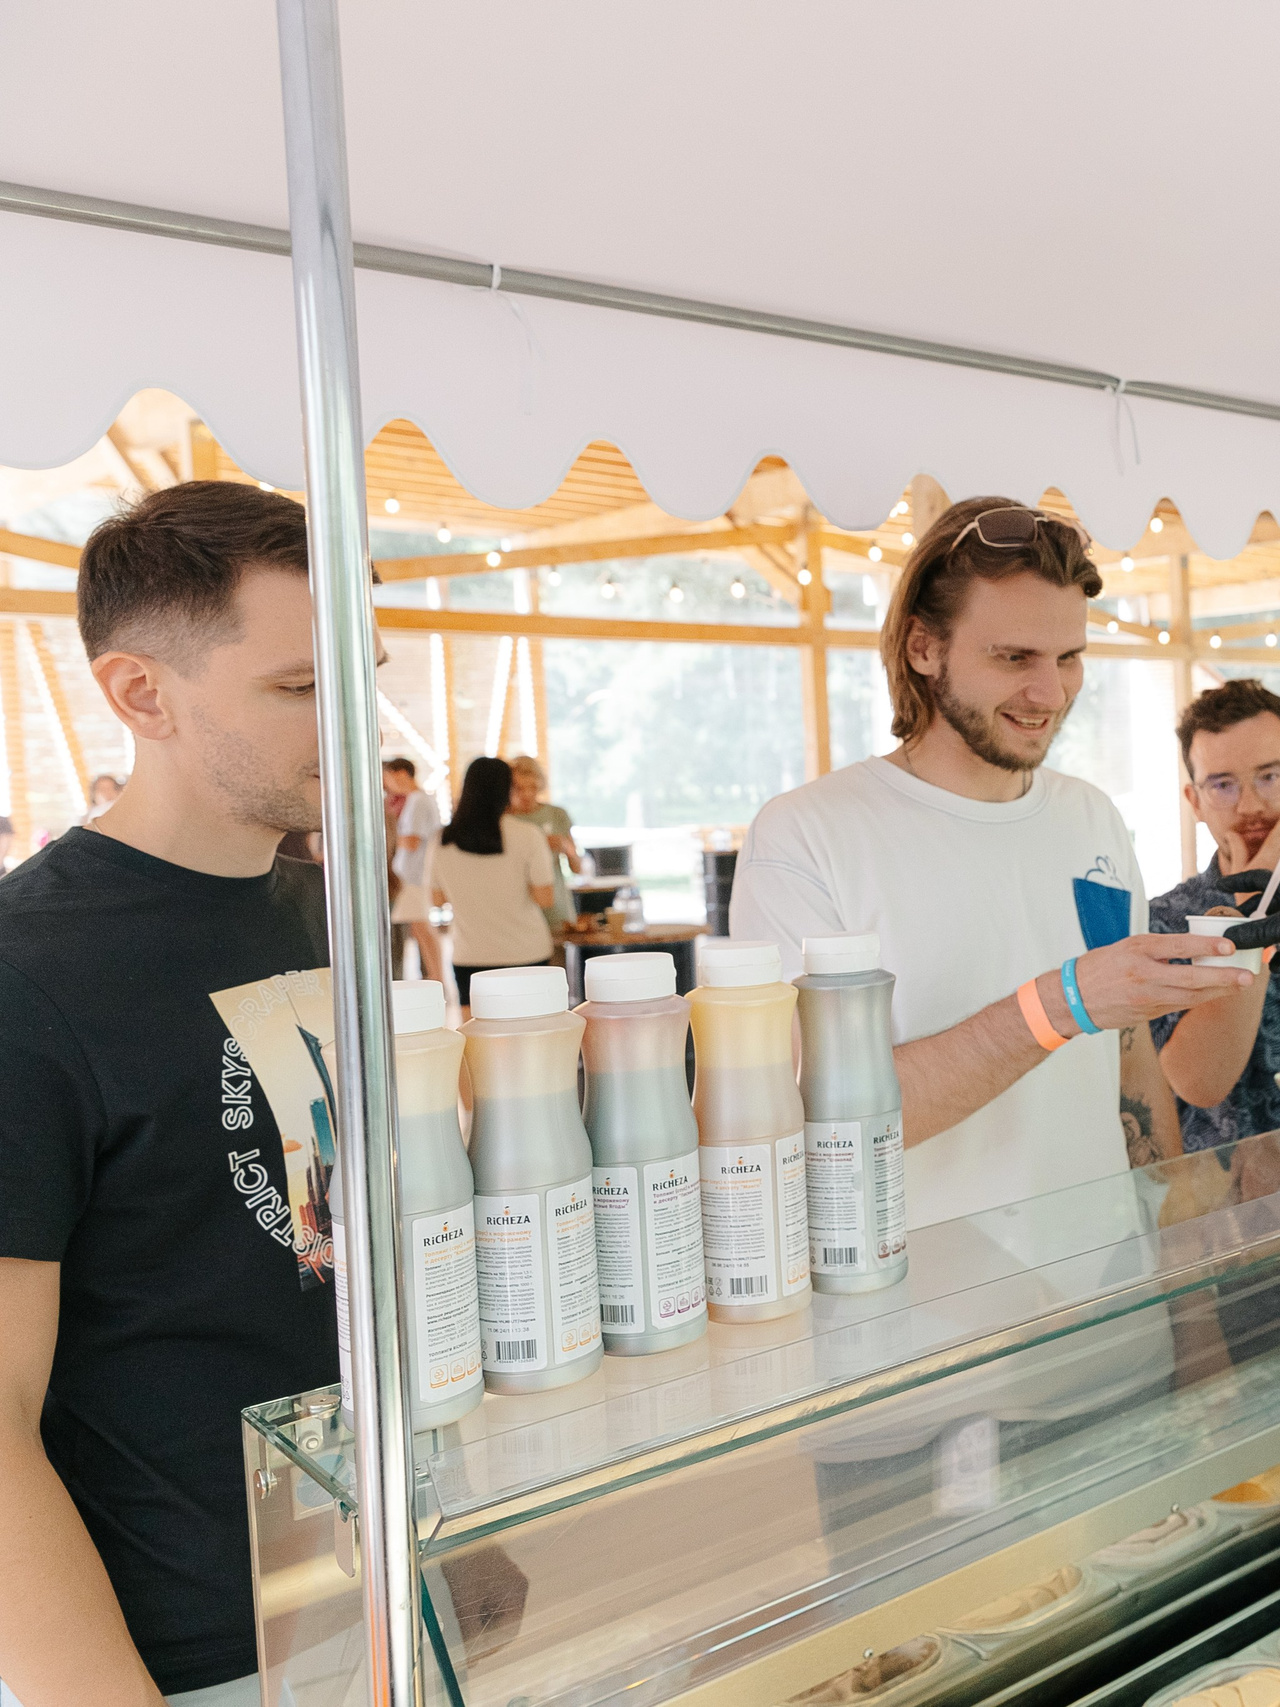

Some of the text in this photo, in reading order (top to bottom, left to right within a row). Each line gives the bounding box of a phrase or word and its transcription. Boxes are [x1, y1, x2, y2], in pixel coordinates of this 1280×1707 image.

[222, 969, 325, 1130] SKYSCRAPER
[721, 1165, 761, 1174] RiCHEZA
[652, 1176, 688, 1191] RiCHEZA
[555, 1199, 588, 1216] RiCHEZA
[486, 1215, 531, 1226] RiCHEZA
[424, 1228, 464, 1246] RiCHEZA
